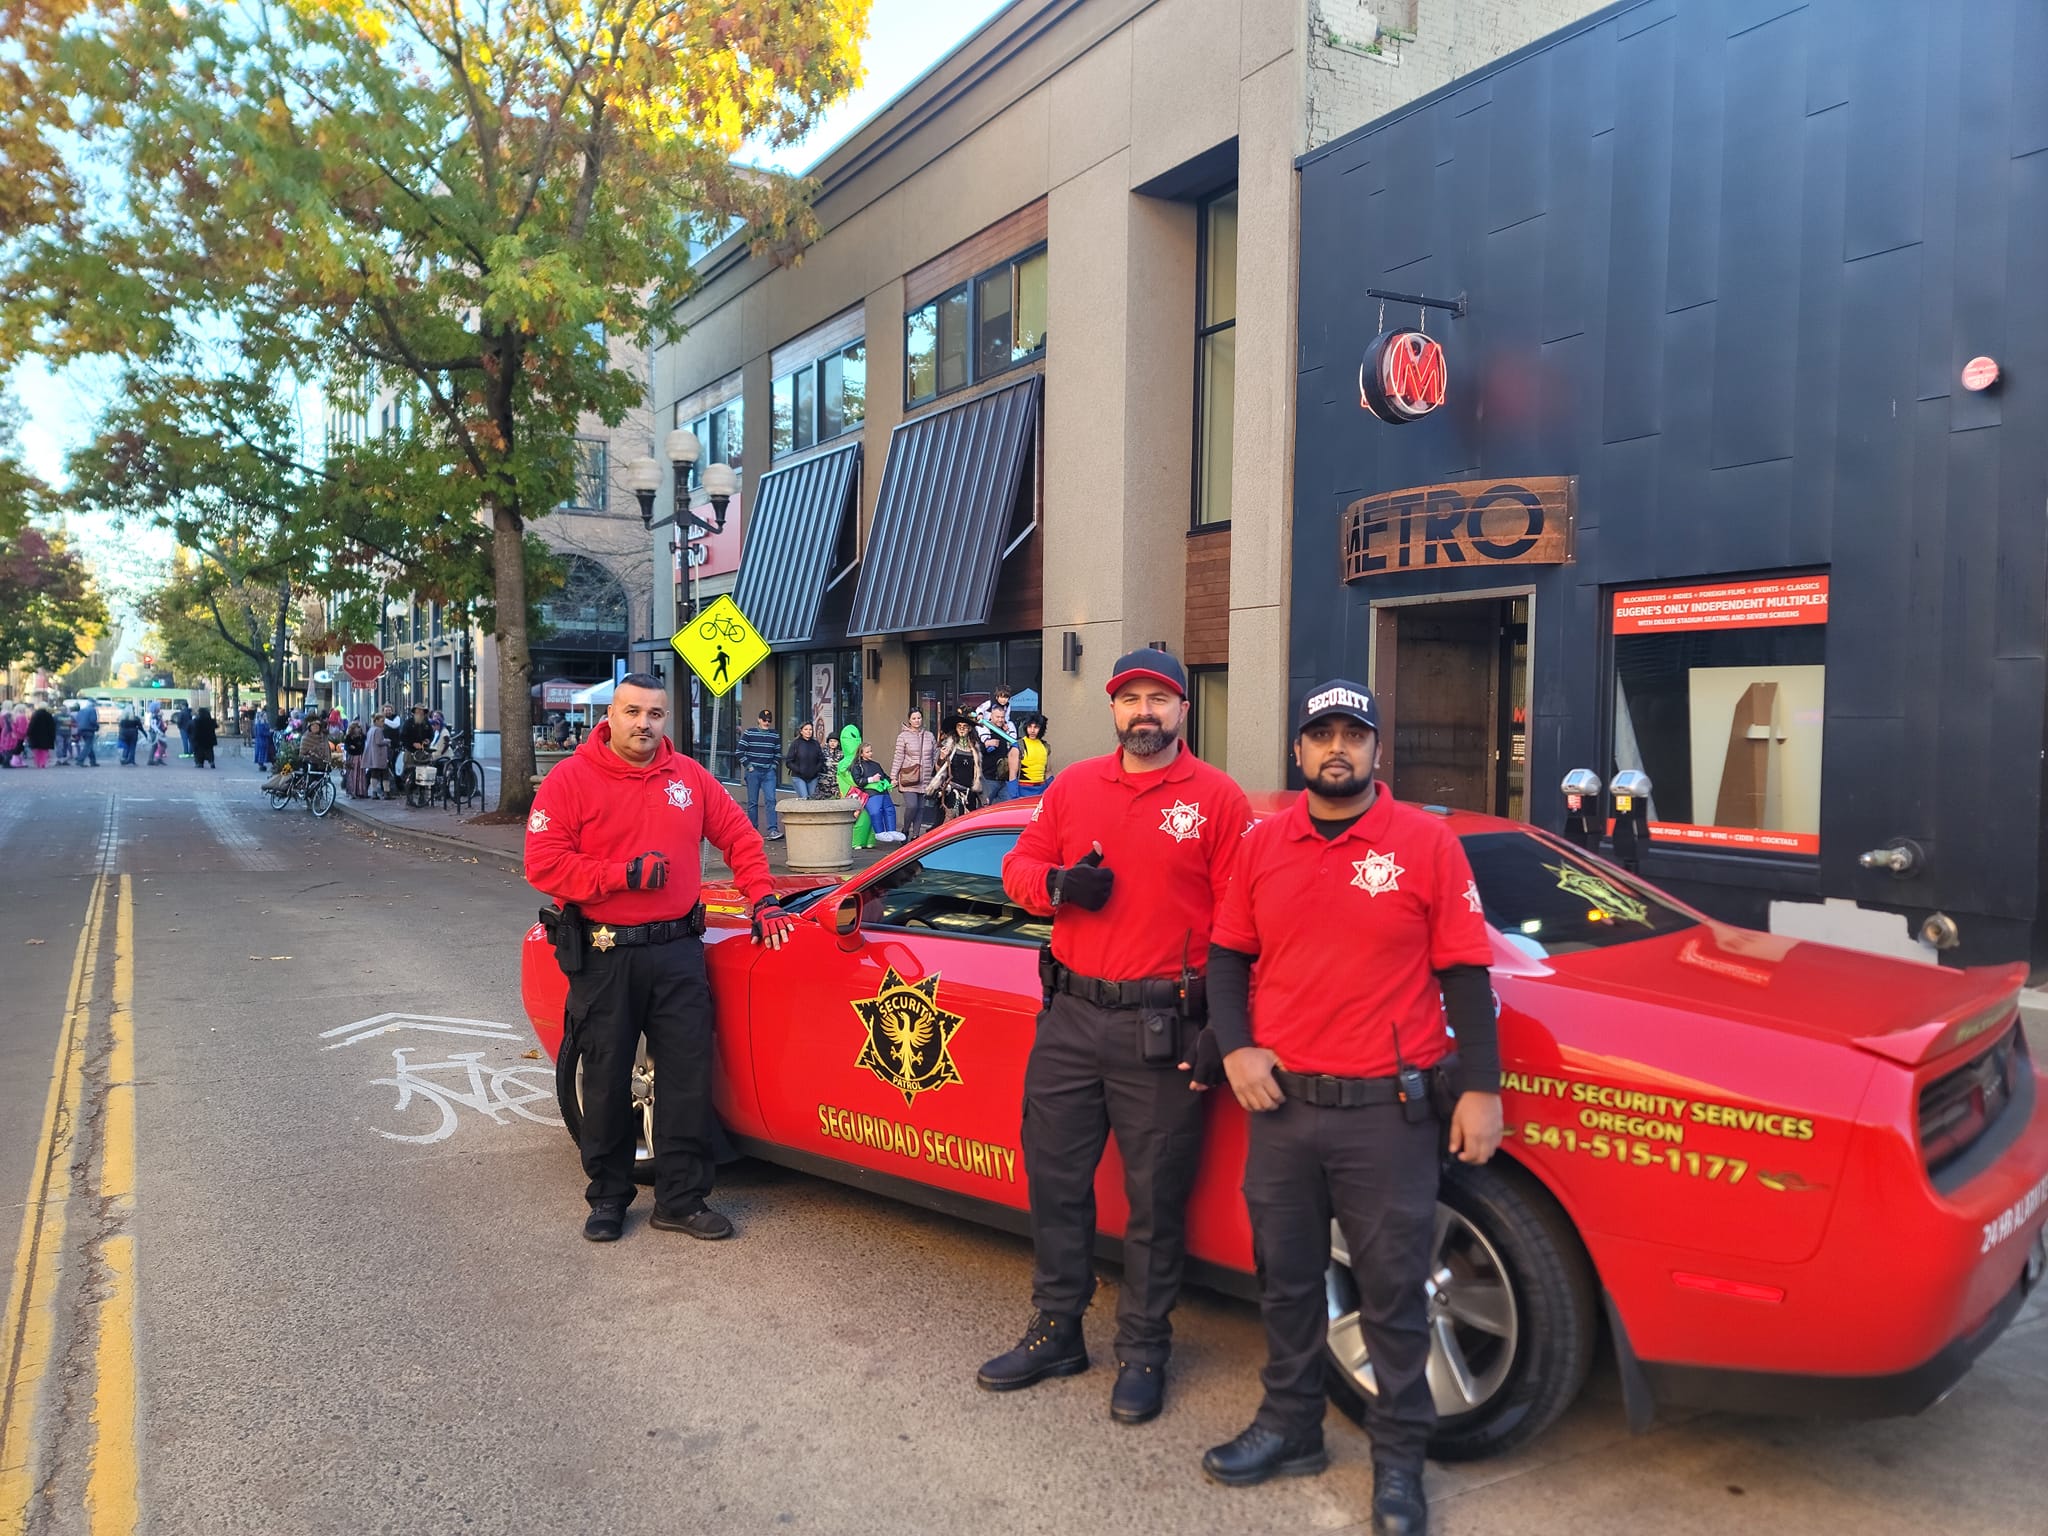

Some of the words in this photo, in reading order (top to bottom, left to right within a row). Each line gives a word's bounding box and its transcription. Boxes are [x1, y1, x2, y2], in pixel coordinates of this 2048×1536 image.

[1385, 332, 1445, 406] M
[1753, 585, 1779, 594] EVENTS
[1786, 582, 1820, 591] CLASSICS
[1616, 605, 1662, 618] EUGENE'S
[1663, 603, 1689, 615] ONLY
[1690, 598, 1765, 613] INDEPENDENT
[1766, 593, 1828, 608] MULTIPLEX
[345, 654, 382, 669] STOP
[1308, 687, 1369, 715] SECURITY
[879, 996, 936, 1024] SECURITY
[892, 1077, 923, 1090] PATROL
[1571, 1082, 1687, 1119] SECURITY
[1690, 1102, 1814, 1141] SERVICES
[1579, 1109, 1684, 1144] OREGON
[818, 1103, 920, 1159] SEGURIDAD
[922, 1128, 1016, 1184] SECURITY
[1523, 1122, 1748, 1185] 541-515-1177
